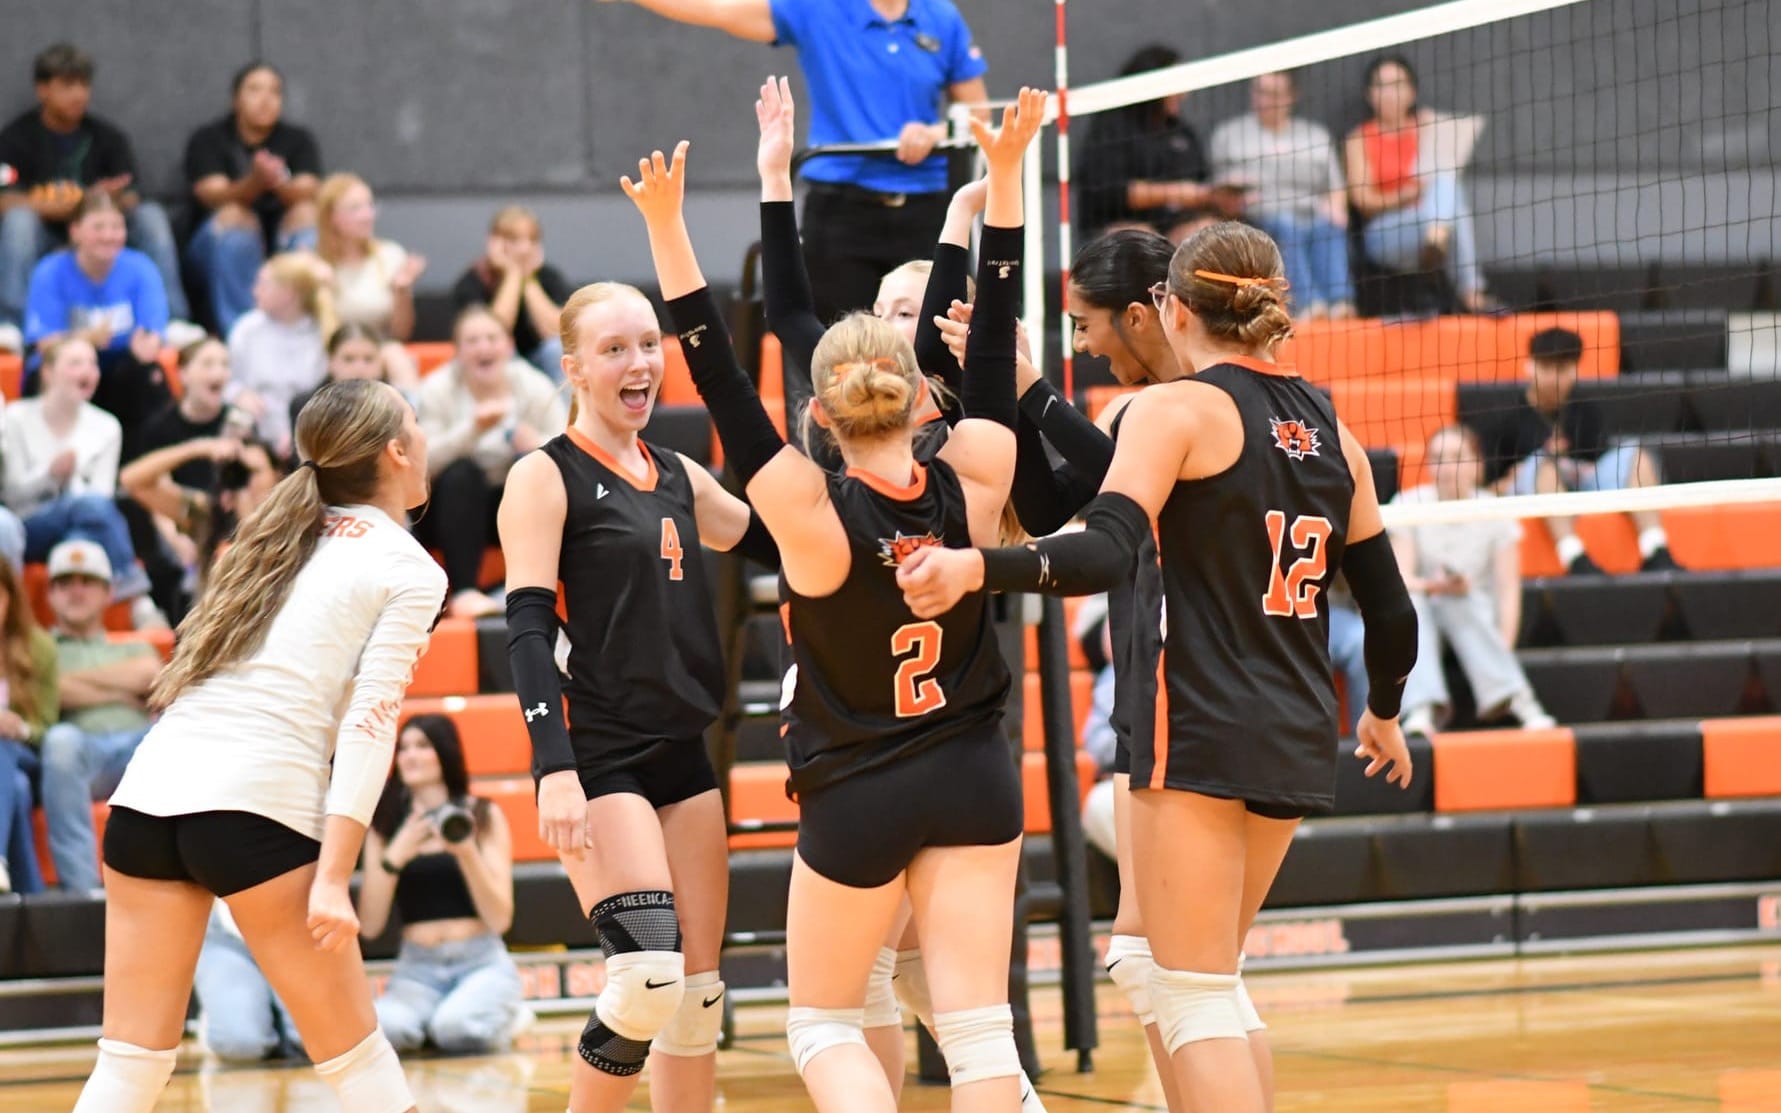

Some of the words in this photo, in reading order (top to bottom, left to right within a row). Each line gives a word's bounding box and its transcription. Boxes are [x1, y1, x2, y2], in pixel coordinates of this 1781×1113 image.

[661, 517, 683, 581] 4
[1262, 510, 1333, 619] 12
[891, 620, 947, 717] 2
